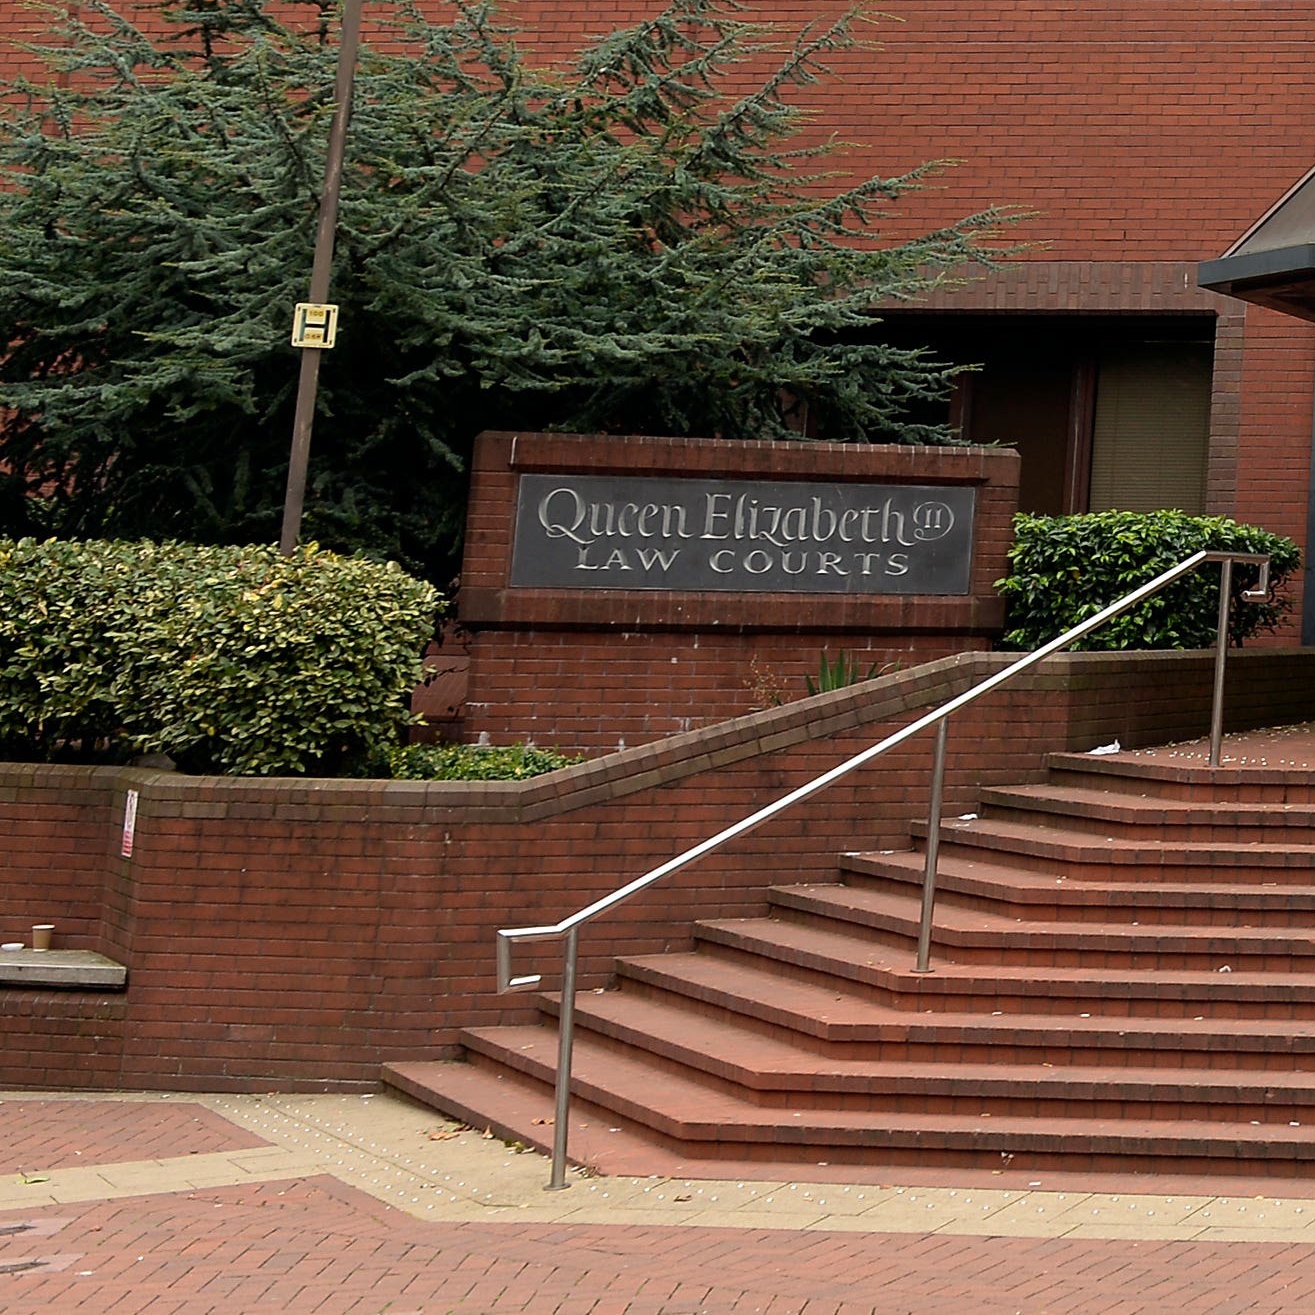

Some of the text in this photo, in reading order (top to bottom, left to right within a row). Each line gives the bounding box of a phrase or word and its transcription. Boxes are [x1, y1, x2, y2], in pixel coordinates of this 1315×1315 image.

[538, 488, 695, 545] Queen
[700, 492, 918, 546] Elizabeth
[573, 547, 909, 576] LAW COURTS
